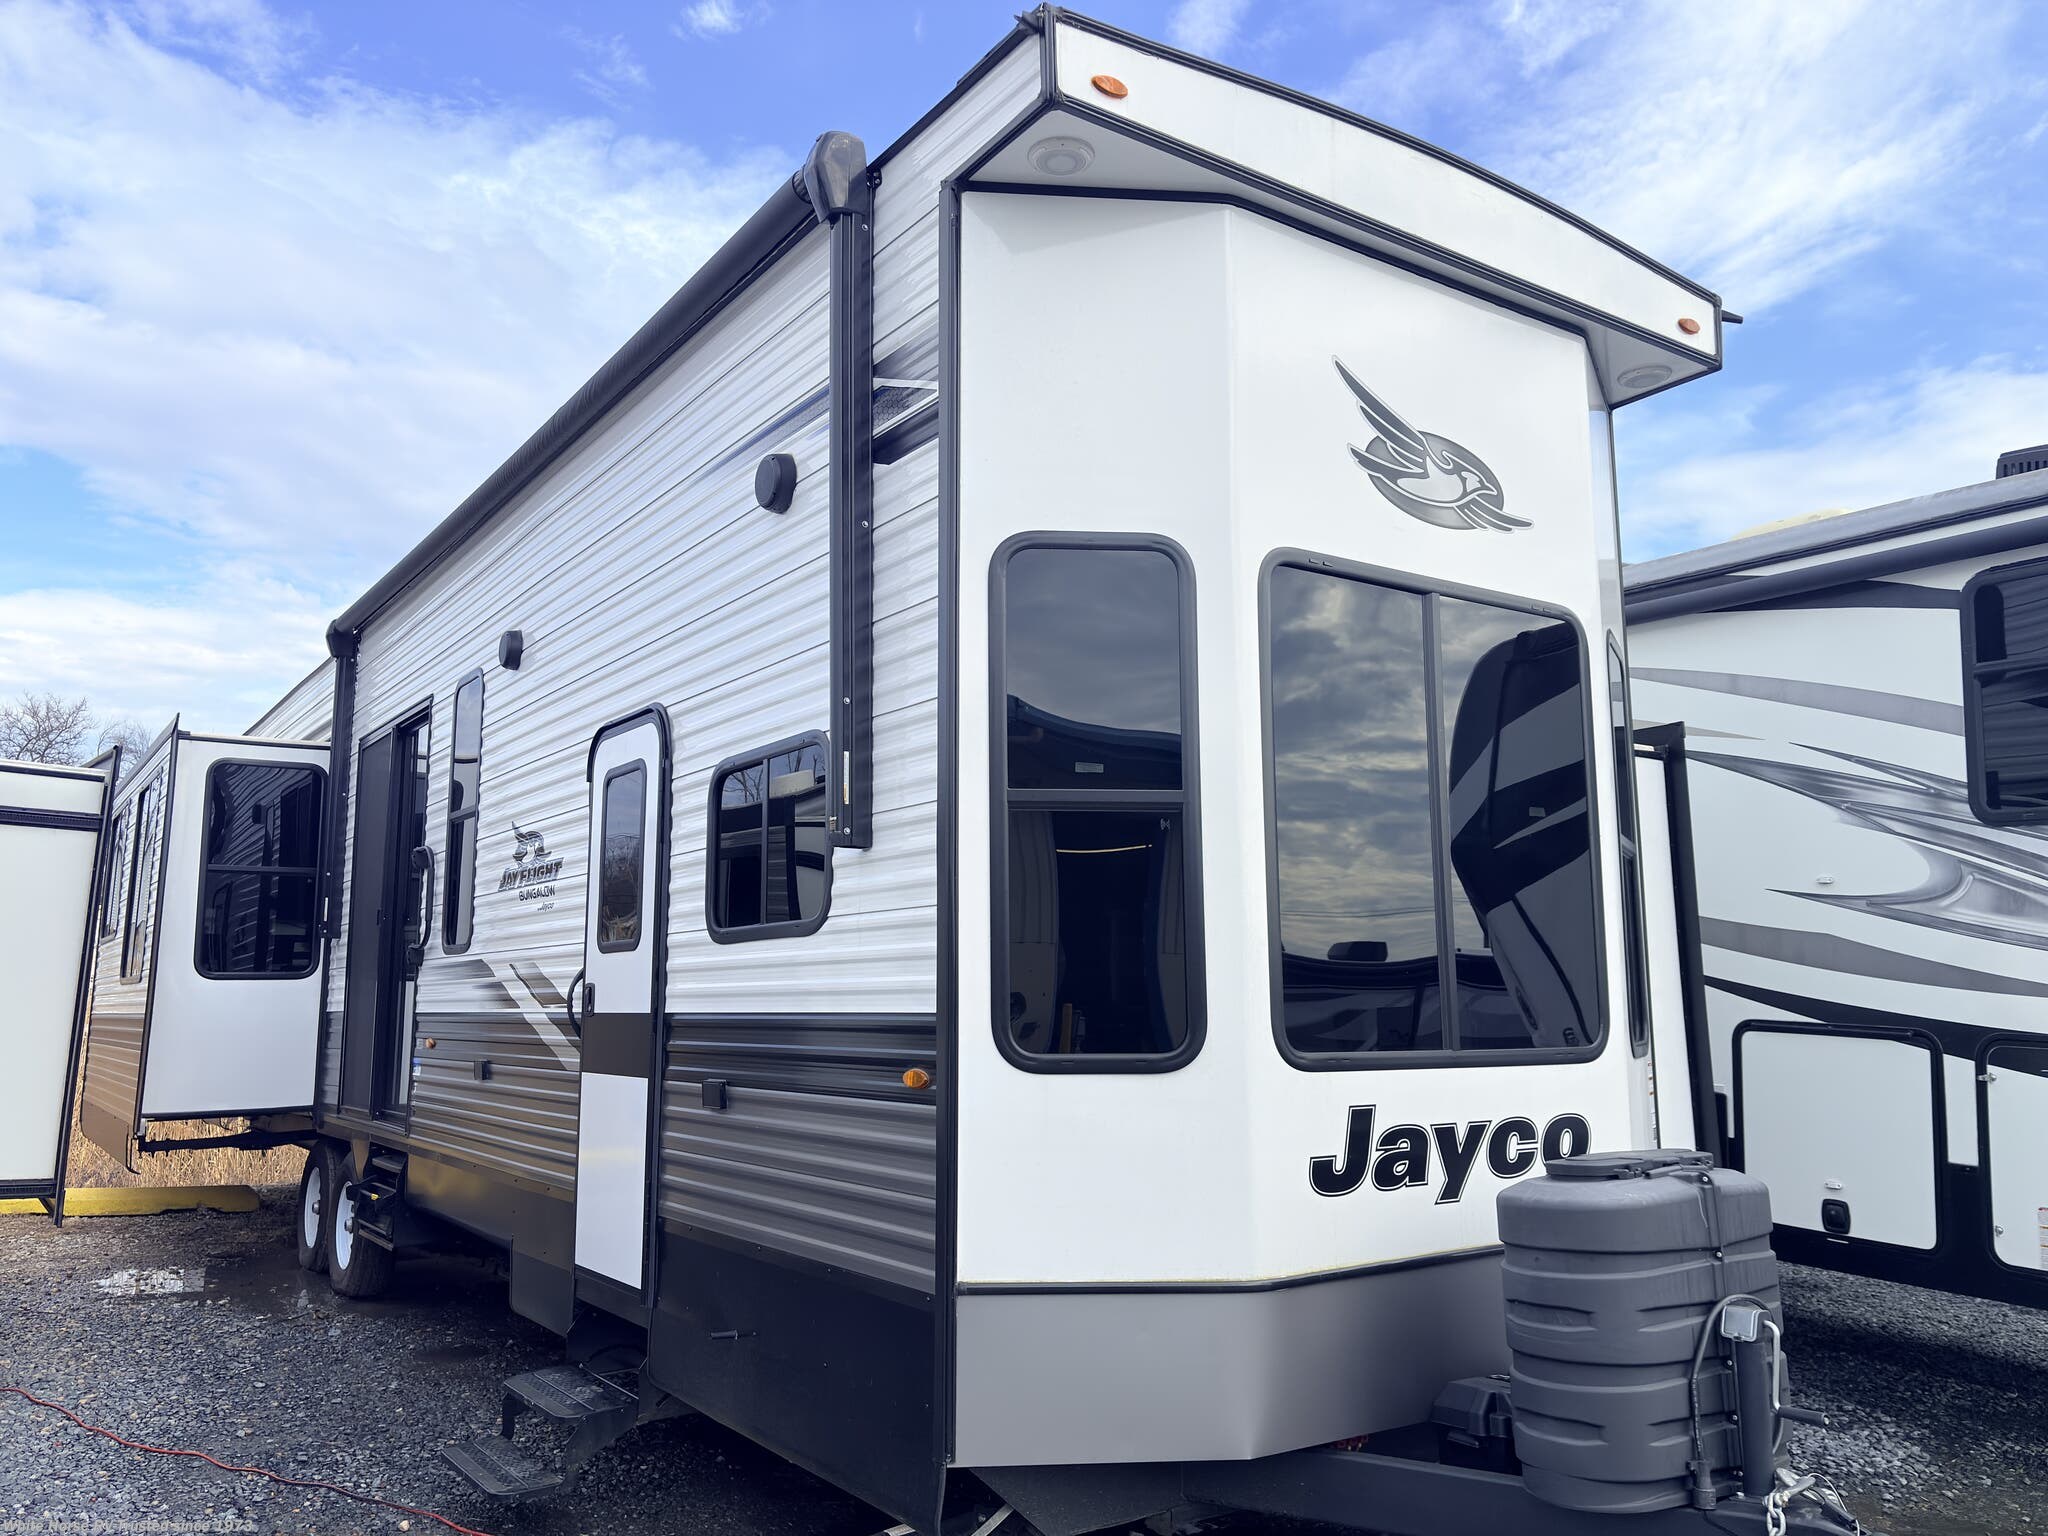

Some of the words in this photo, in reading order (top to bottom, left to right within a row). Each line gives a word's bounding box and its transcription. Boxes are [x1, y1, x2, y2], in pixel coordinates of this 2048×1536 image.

[498, 868, 519, 890] JAY
[518, 860, 563, 885] FLIGHT
[519, 885, 556, 901] BUNGALOW
[1308, 1104, 1592, 1205] Jayco
